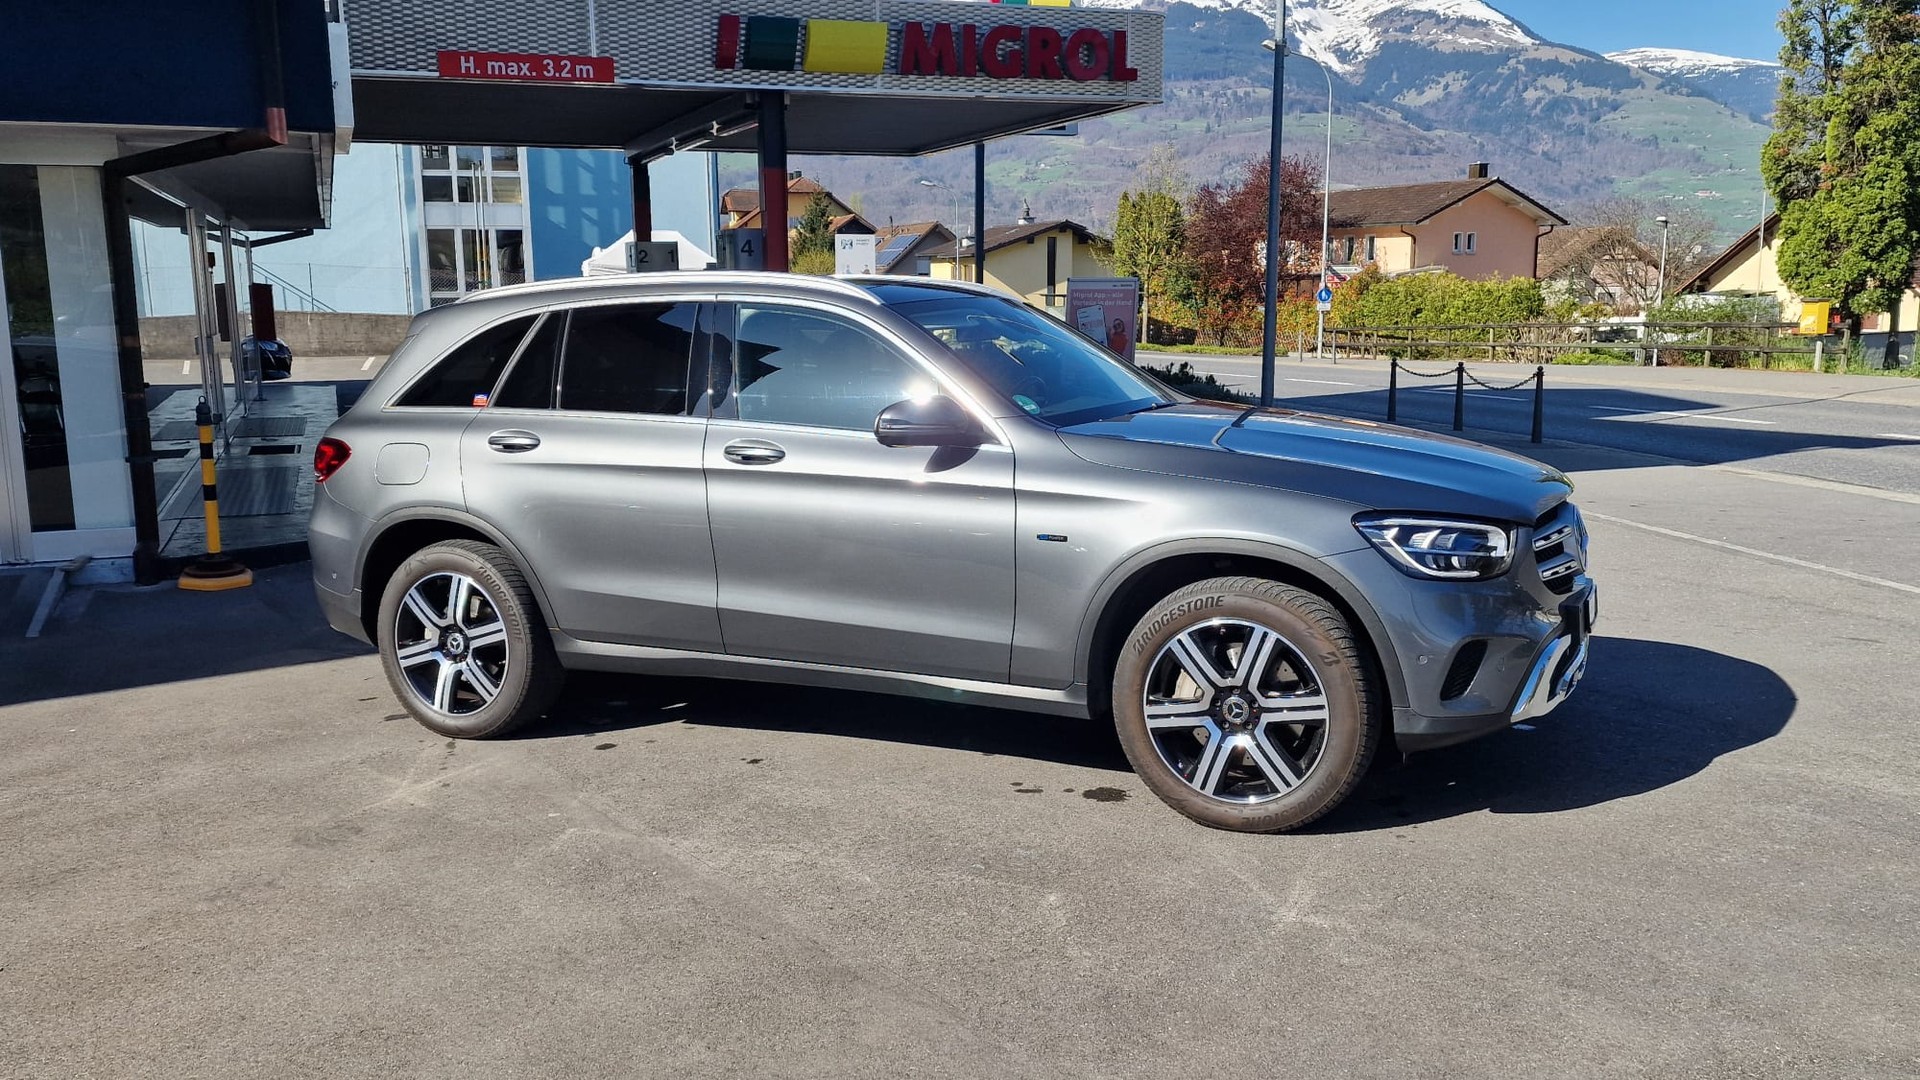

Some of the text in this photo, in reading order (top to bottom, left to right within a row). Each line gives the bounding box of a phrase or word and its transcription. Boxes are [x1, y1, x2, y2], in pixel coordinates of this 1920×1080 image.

[460, 55, 480, 75] H.
[487, 60, 537, 77] max.
[901, 21, 1138, 81] MIGROL
[638, 249, 675, 264] 2 1
[740, 238, 755, 257] 4
[477, 566, 524, 644] BRIDGESTONE
[1132, 594, 1226, 658] BRIDGESTONE
